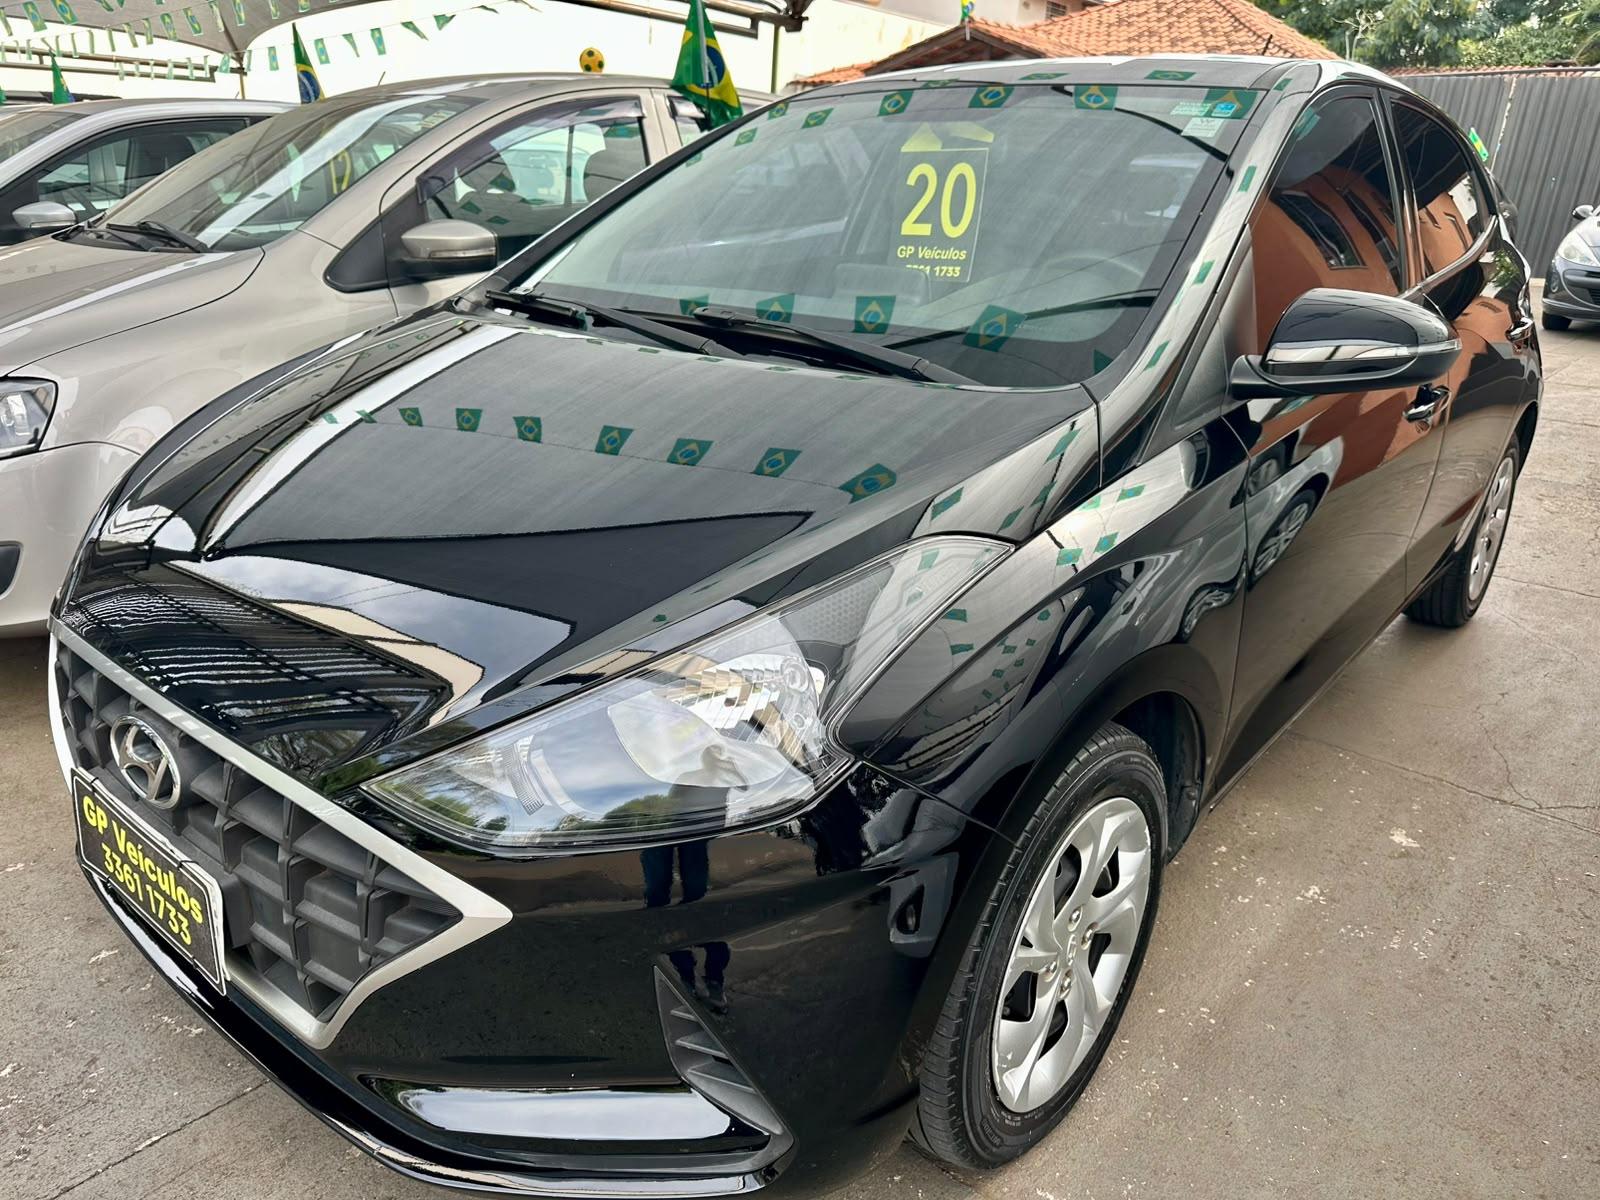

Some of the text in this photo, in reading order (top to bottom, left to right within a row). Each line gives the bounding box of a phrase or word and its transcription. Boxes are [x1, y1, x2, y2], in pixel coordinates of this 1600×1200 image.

[901, 163, 976, 238] 20
[897, 245, 967, 260] GP Veículos
[83, 796, 203, 924] GP Veículos
[102, 843, 191, 945] 3361 1733
